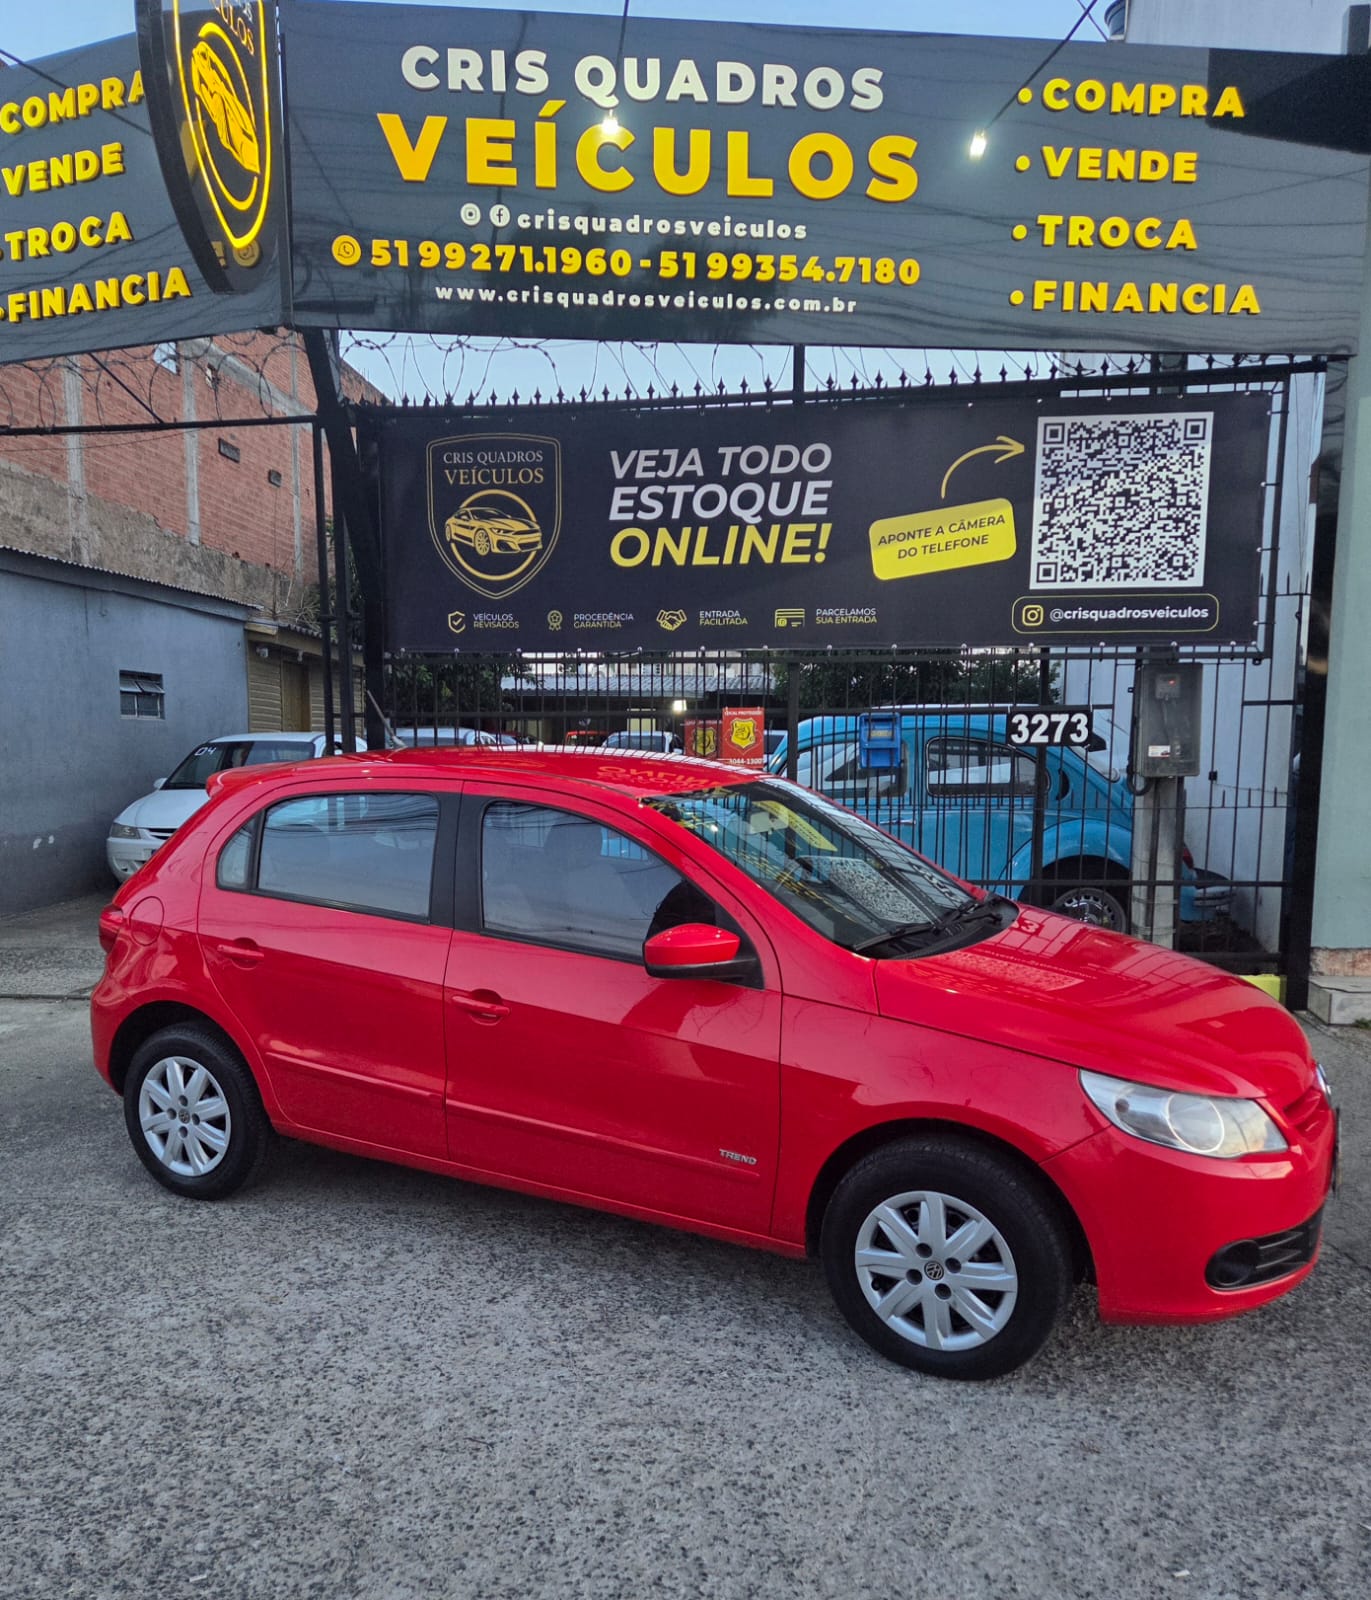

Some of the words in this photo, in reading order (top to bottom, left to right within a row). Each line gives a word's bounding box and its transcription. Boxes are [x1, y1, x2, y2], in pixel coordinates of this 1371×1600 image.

[401, 45, 549, 95] CRIS
[574, 55, 884, 112] QUADROS
[1042, 78, 1245, 118] COMPRA
[376, 99, 919, 202] VEÍCULOS
[1041, 146, 1198, 182] VENDE
[1, 142, 124, 196] VENDE
[4, 211, 133, 261] TROCA
[517, 208, 807, 239] crisquadrosveiculos
[1036, 214, 1198, 250] TROCA
[371, 239, 408, 267] 51
[418, 240, 632, 277] 99271.1960
[659, 251, 696, 279] 51
[706, 252, 920, 285] 99354.7180
[8, 267, 191, 323] FINANCIA
[435, 285, 857, 313] www.crisquadrosveiculos.com.br
[1032, 280, 1261, 314] FINANCIA
[443, 452, 474, 464] CRIS
[477, 450, 543, 465] QUADROS
[609, 447, 704, 480] VEJA
[717, 442, 833, 476] TODO
[444, 466, 544, 485] VEÍCULOS
[608, 480, 833, 524] ESTOQUE
[878, 527, 932, 546] APONTE
[935, 526, 945, 536] A
[948, 514, 1005, 533] CÂMERA
[609, 523, 833, 568] ONLINE!
[898, 547, 918, 559] DO
[921, 534, 989, 555] TELEFONE
[473, 612, 513, 621] VEÍCULOS
[473, 620, 520, 629] REVISADOS
[573, 611, 634, 621] PROCEDÊNCIA
[573, 620, 622, 629] GARANTIDA
[699, 610, 740, 618] ENTRADA
[699, 617, 748, 626] FACILITADA
[815, 616, 834, 624] SUA
[835, 615, 877, 624] ENTRADA
[816, 608, 876, 617] PARCELAMOS
[1050, 606, 1209, 622] @crisquadrosveiculos
[1011, 713, 1089, 743] 3273
[719, 1148, 757, 1166] TREND
